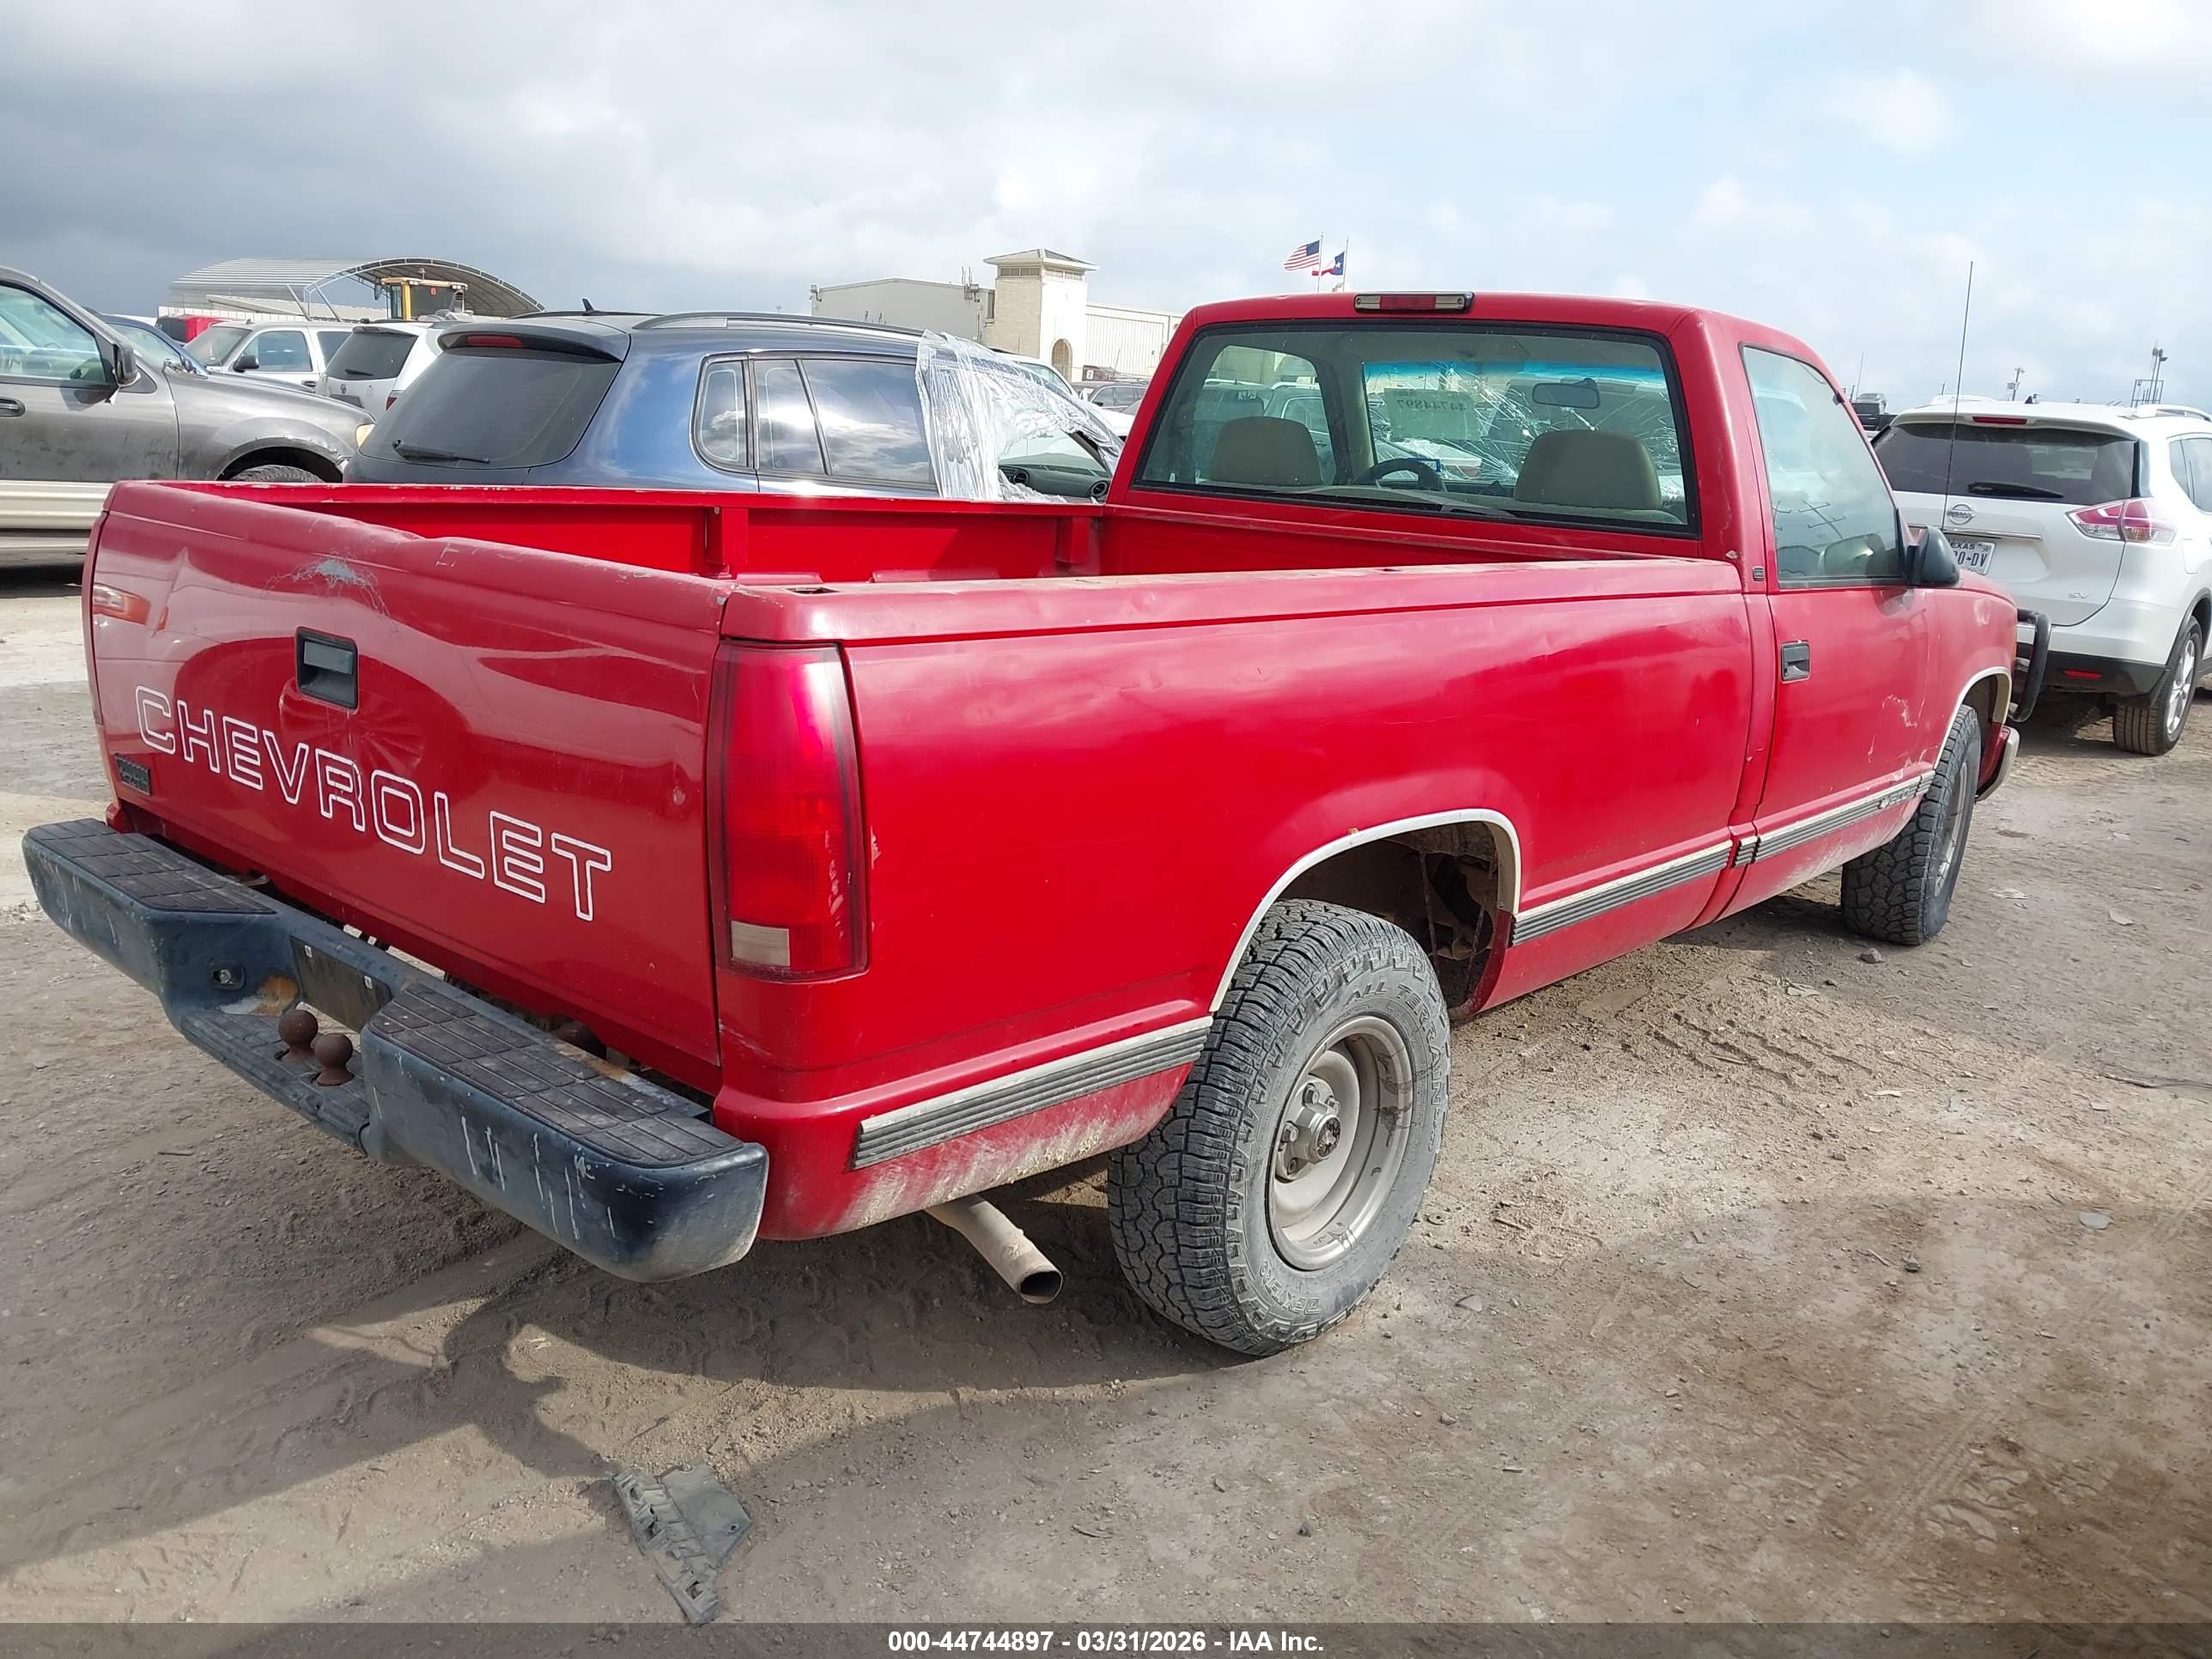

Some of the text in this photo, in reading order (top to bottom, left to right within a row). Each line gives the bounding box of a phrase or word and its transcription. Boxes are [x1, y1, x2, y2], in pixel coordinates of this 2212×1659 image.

[1950, 542, 1975, 550] EXAS
[136, 685, 612, 922] CHEVROLET
[1341, 981, 1388, 1012] ALL
[1395, 983, 1442, 1106] TERRAIN
